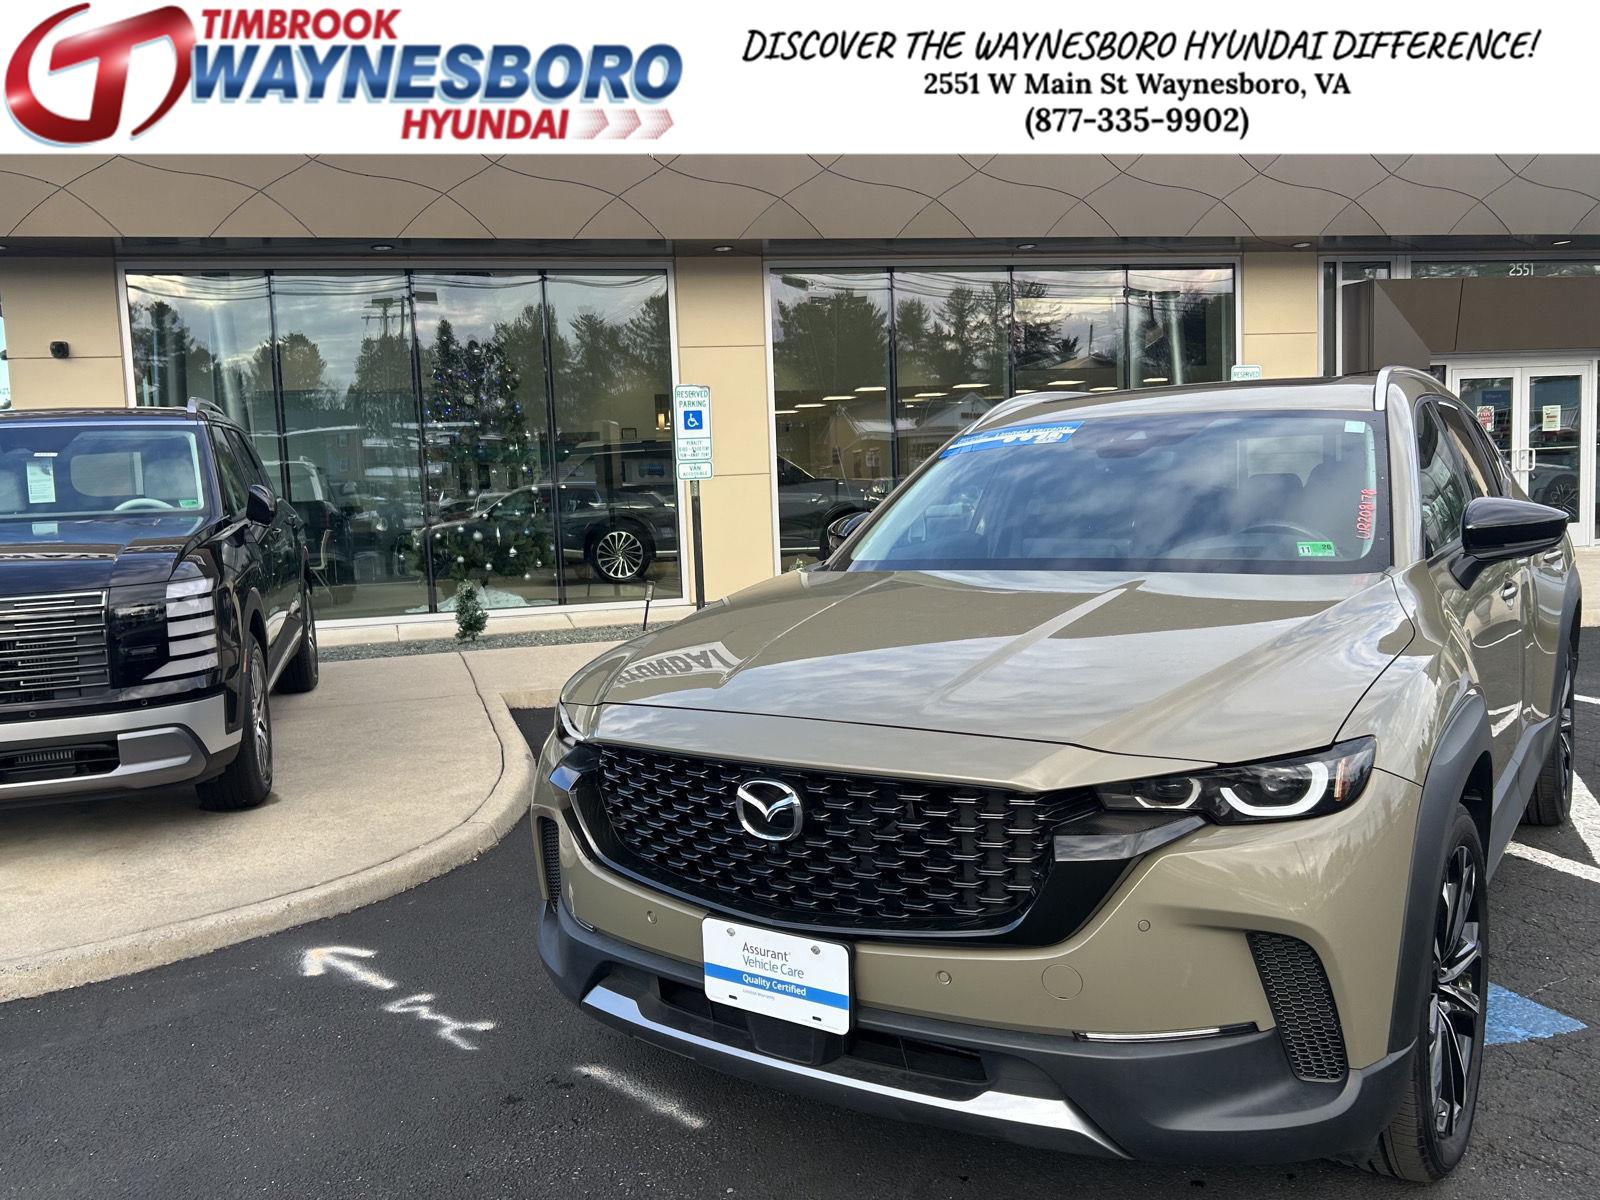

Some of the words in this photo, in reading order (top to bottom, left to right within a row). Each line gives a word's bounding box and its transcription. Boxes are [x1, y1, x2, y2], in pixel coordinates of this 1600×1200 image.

[1509, 262, 1534, 276] 2551
[676, 390, 709, 399] RESERVED
[679, 400, 707, 408] PARKING
[742, 942, 789, 962] Assurant
[742, 955, 779, 973] Vehicle
[780, 963, 805, 979] Care
[742, 974, 771, 990] Quality
[772, 980, 807, 996] Certified
